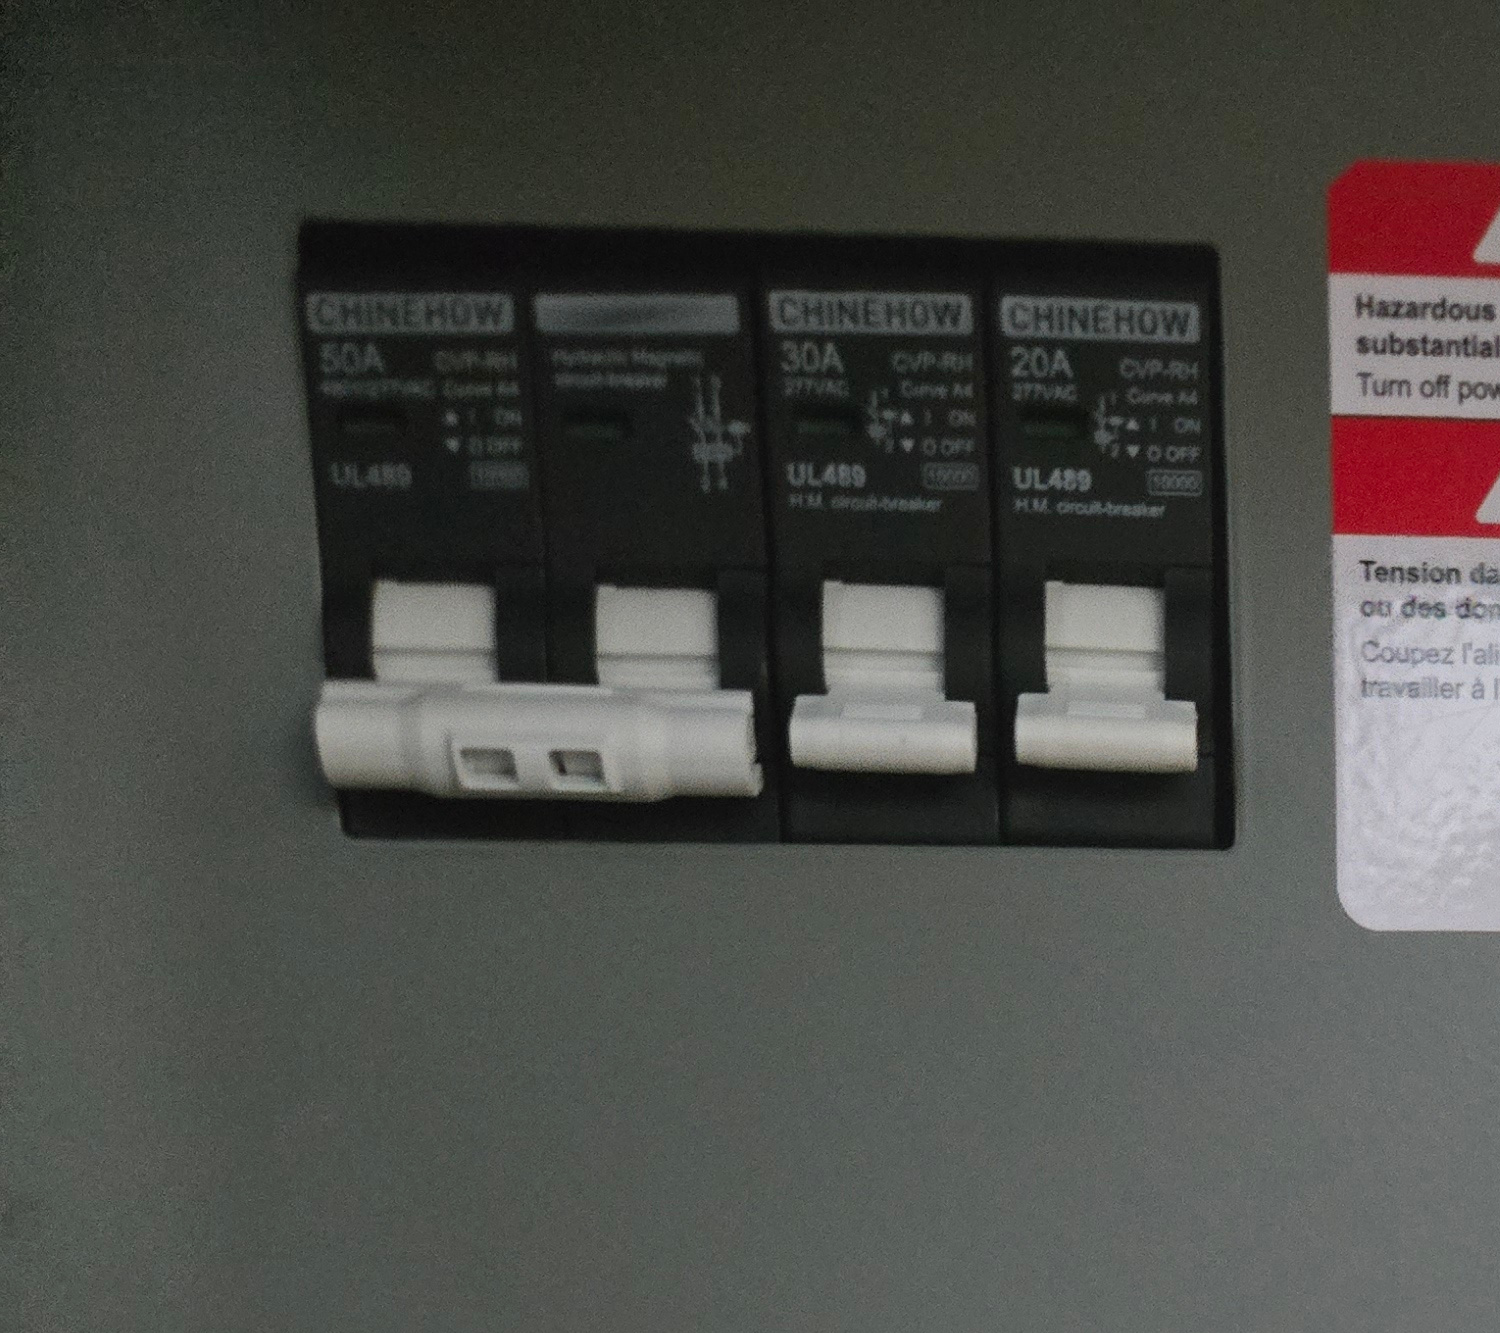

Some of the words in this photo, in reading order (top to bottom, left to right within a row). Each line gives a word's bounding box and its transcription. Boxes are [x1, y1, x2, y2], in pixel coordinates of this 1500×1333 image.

[314, 300, 505, 330] CHINEHOW
[777, 298, 963, 331] CHINEHOW
[1356, 294, 1495, 322] Hazardous
[1009, 304, 1191, 338] CHINEHOW
[780, 340, 845, 374] 30A
[1356, 332, 1500, 358] substantial
[320, 342, 384, 374] 50A
[1010, 346, 1074, 379] 20A
[1118, 357, 1200, 380] CVP-RH
[1126, 387, 1173, 404] Curve
[1356, 373, 1411, 398] Turn
[1420, 375, 1450, 399] off
[948, 410, 975, 427] ON
[1173, 417, 1201, 434] ON
[940, 438, 976, 456] OFF
[1165, 446, 1201, 463] OFF
[786, 462, 867, 488] UL489
[1012, 467, 1093, 492] UL489
[1013, 498, 1050, 514] H.M.
[1056, 499, 1166, 518] circuit-breaker
[1360, 560, 1461, 585] Tension
[1360, 601, 1392, 619] ou
[1402, 596, 1446, 620] des
[1360, 640, 1454, 668] Coupez
[1361, 677, 1464, 700] travailler
[1472, 677, 1485, 700] à
